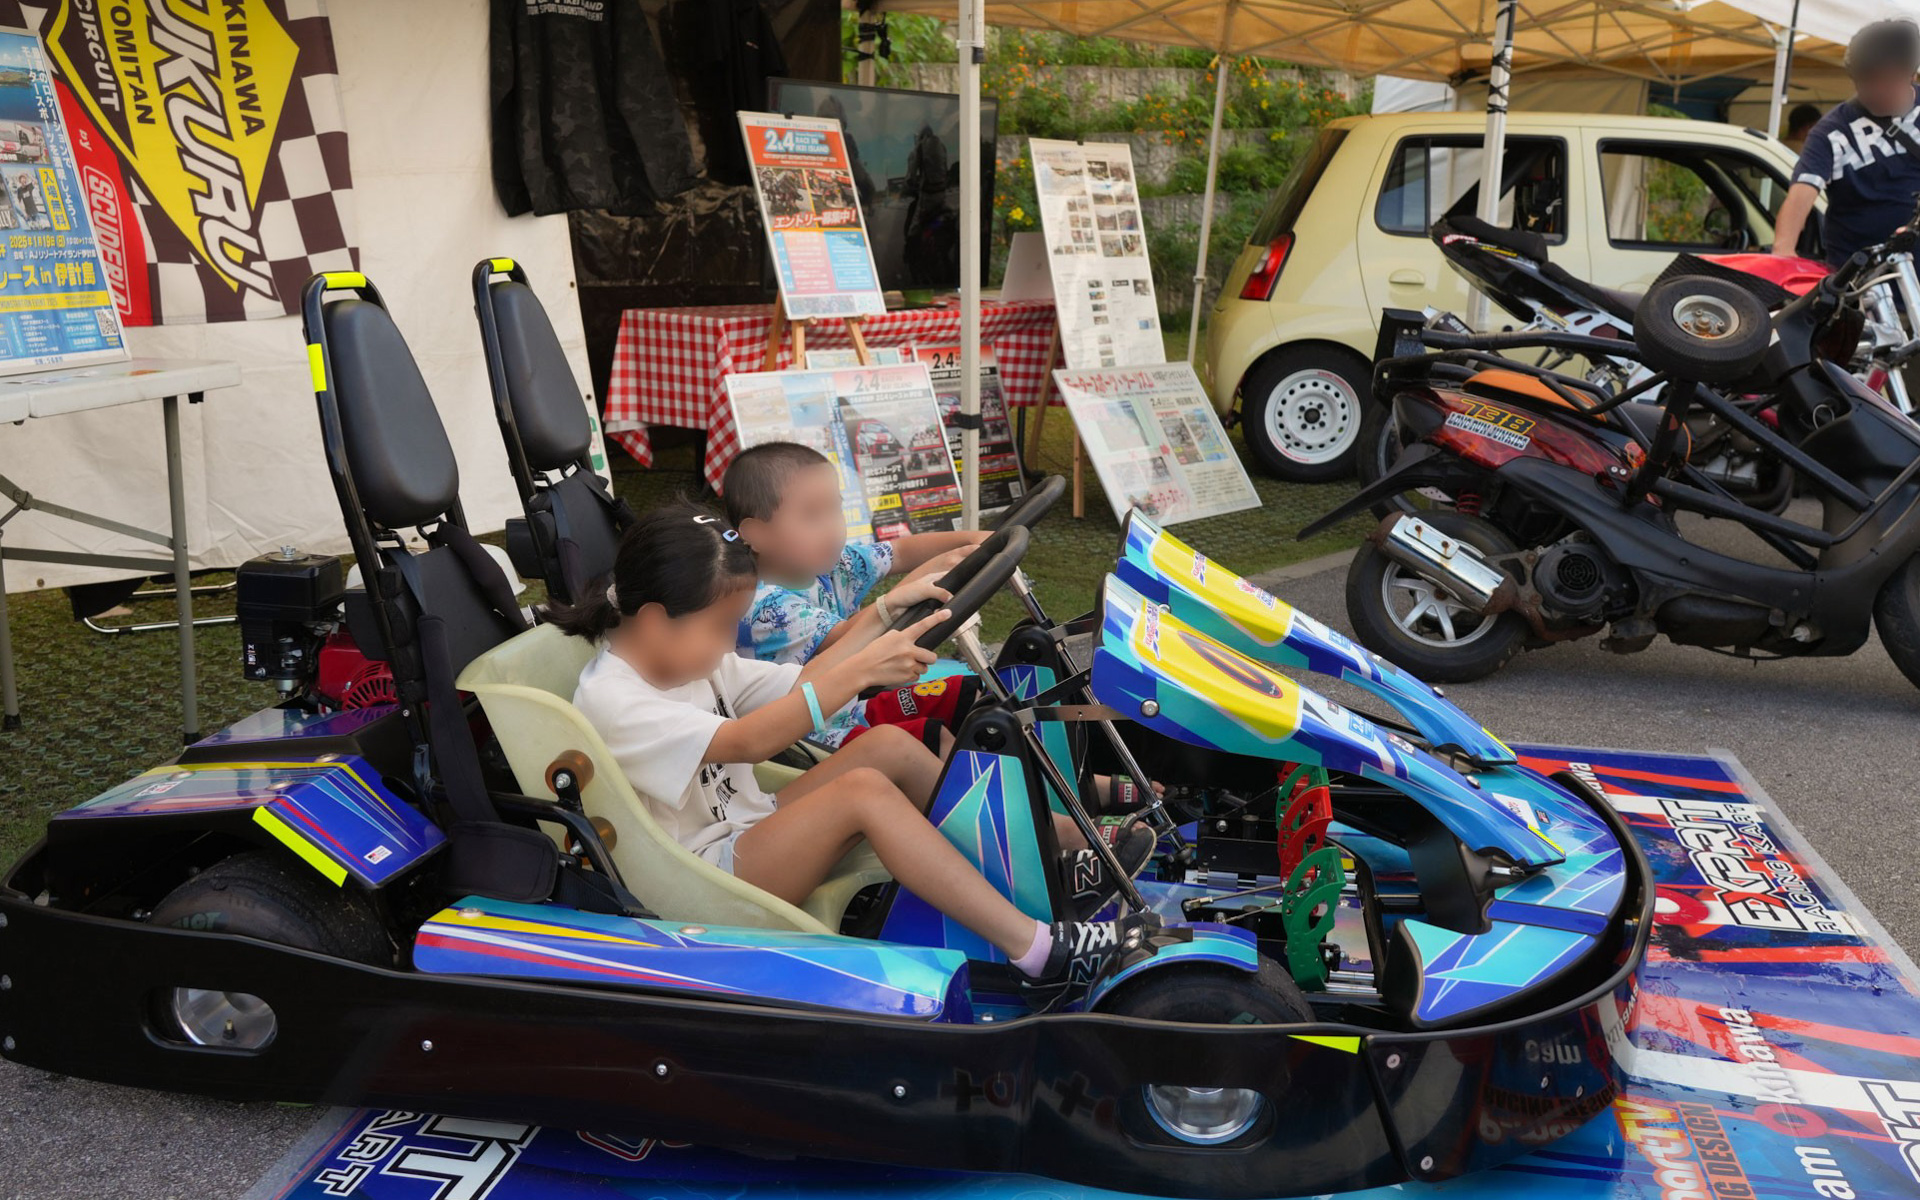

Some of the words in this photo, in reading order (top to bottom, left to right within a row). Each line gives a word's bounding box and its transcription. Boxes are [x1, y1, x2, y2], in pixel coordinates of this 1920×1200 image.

[76, 0, 120, 112] CIRCUIT
[79, 128, 94, 152] by
[87, 172, 128, 313] SCUDERIA
[1657, 798, 1807, 932] EXPRIT
[1723, 803, 1781, 855] KART
[1764, 859, 1843, 934] RACING
